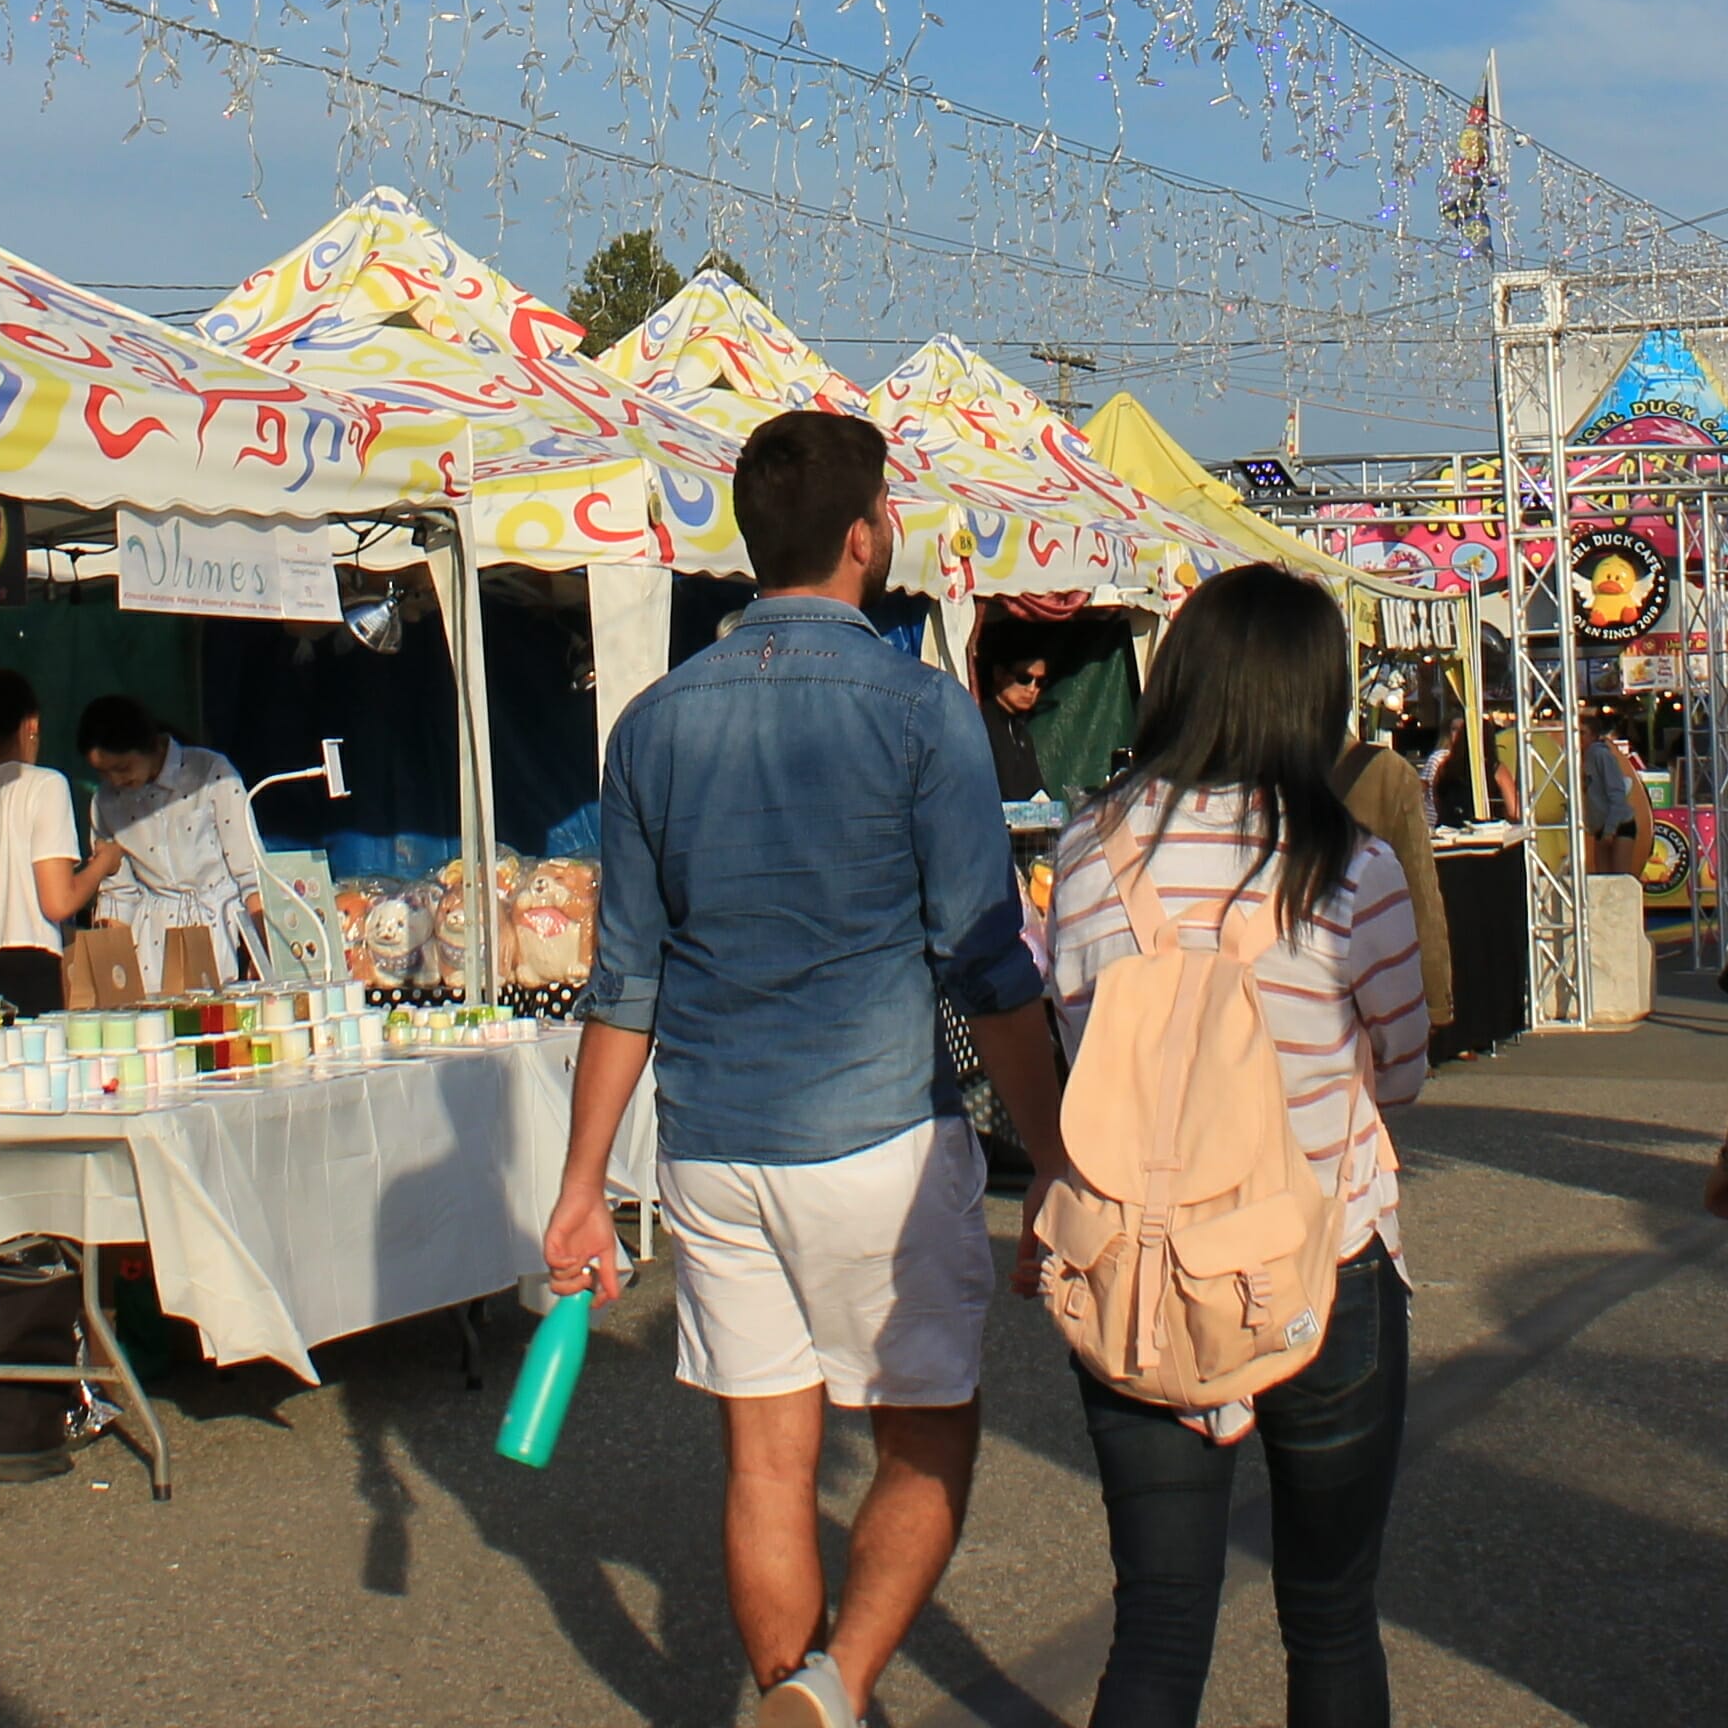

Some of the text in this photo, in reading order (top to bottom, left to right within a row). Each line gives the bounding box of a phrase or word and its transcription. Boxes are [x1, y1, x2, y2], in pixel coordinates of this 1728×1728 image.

[1631, 399, 1698, 422] DUCK
[1592, 533, 1634, 549] DUCK
[1634, 541, 1662, 573] CAFE
[1602, 626, 1638, 640] SINCE
[1636, 605, 1659, 630] 2019
